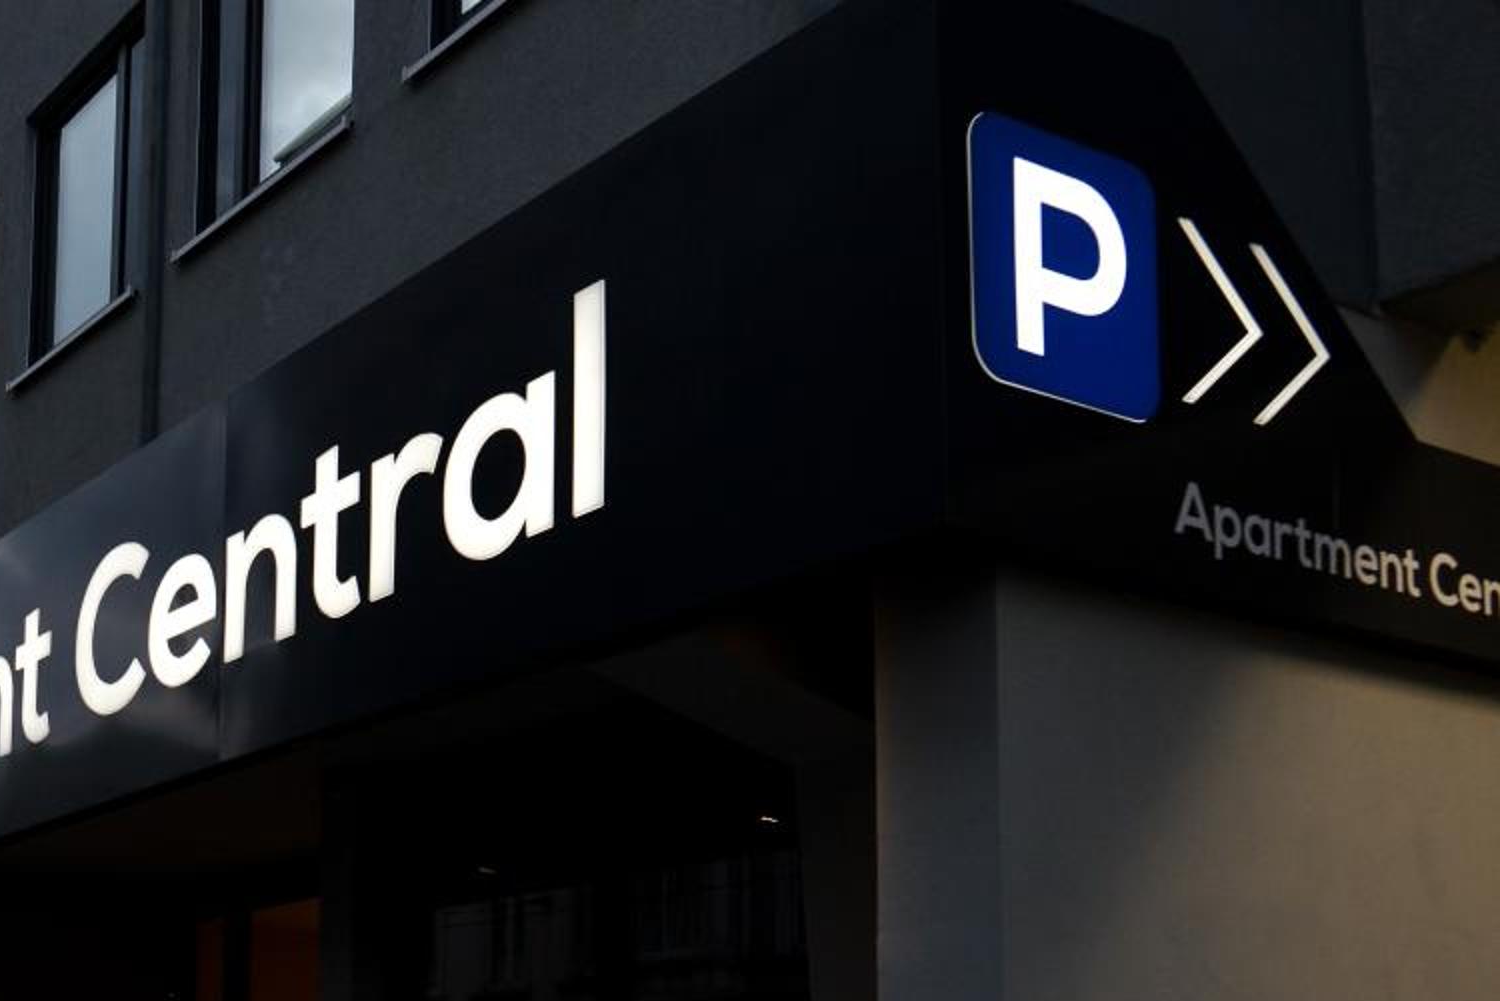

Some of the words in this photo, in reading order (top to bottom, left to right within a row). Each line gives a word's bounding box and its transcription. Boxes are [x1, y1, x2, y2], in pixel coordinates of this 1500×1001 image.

[1012, 155, 1127, 358] P
[74, 279, 607, 717] Central
[1173, 480, 1423, 598] Apartment
